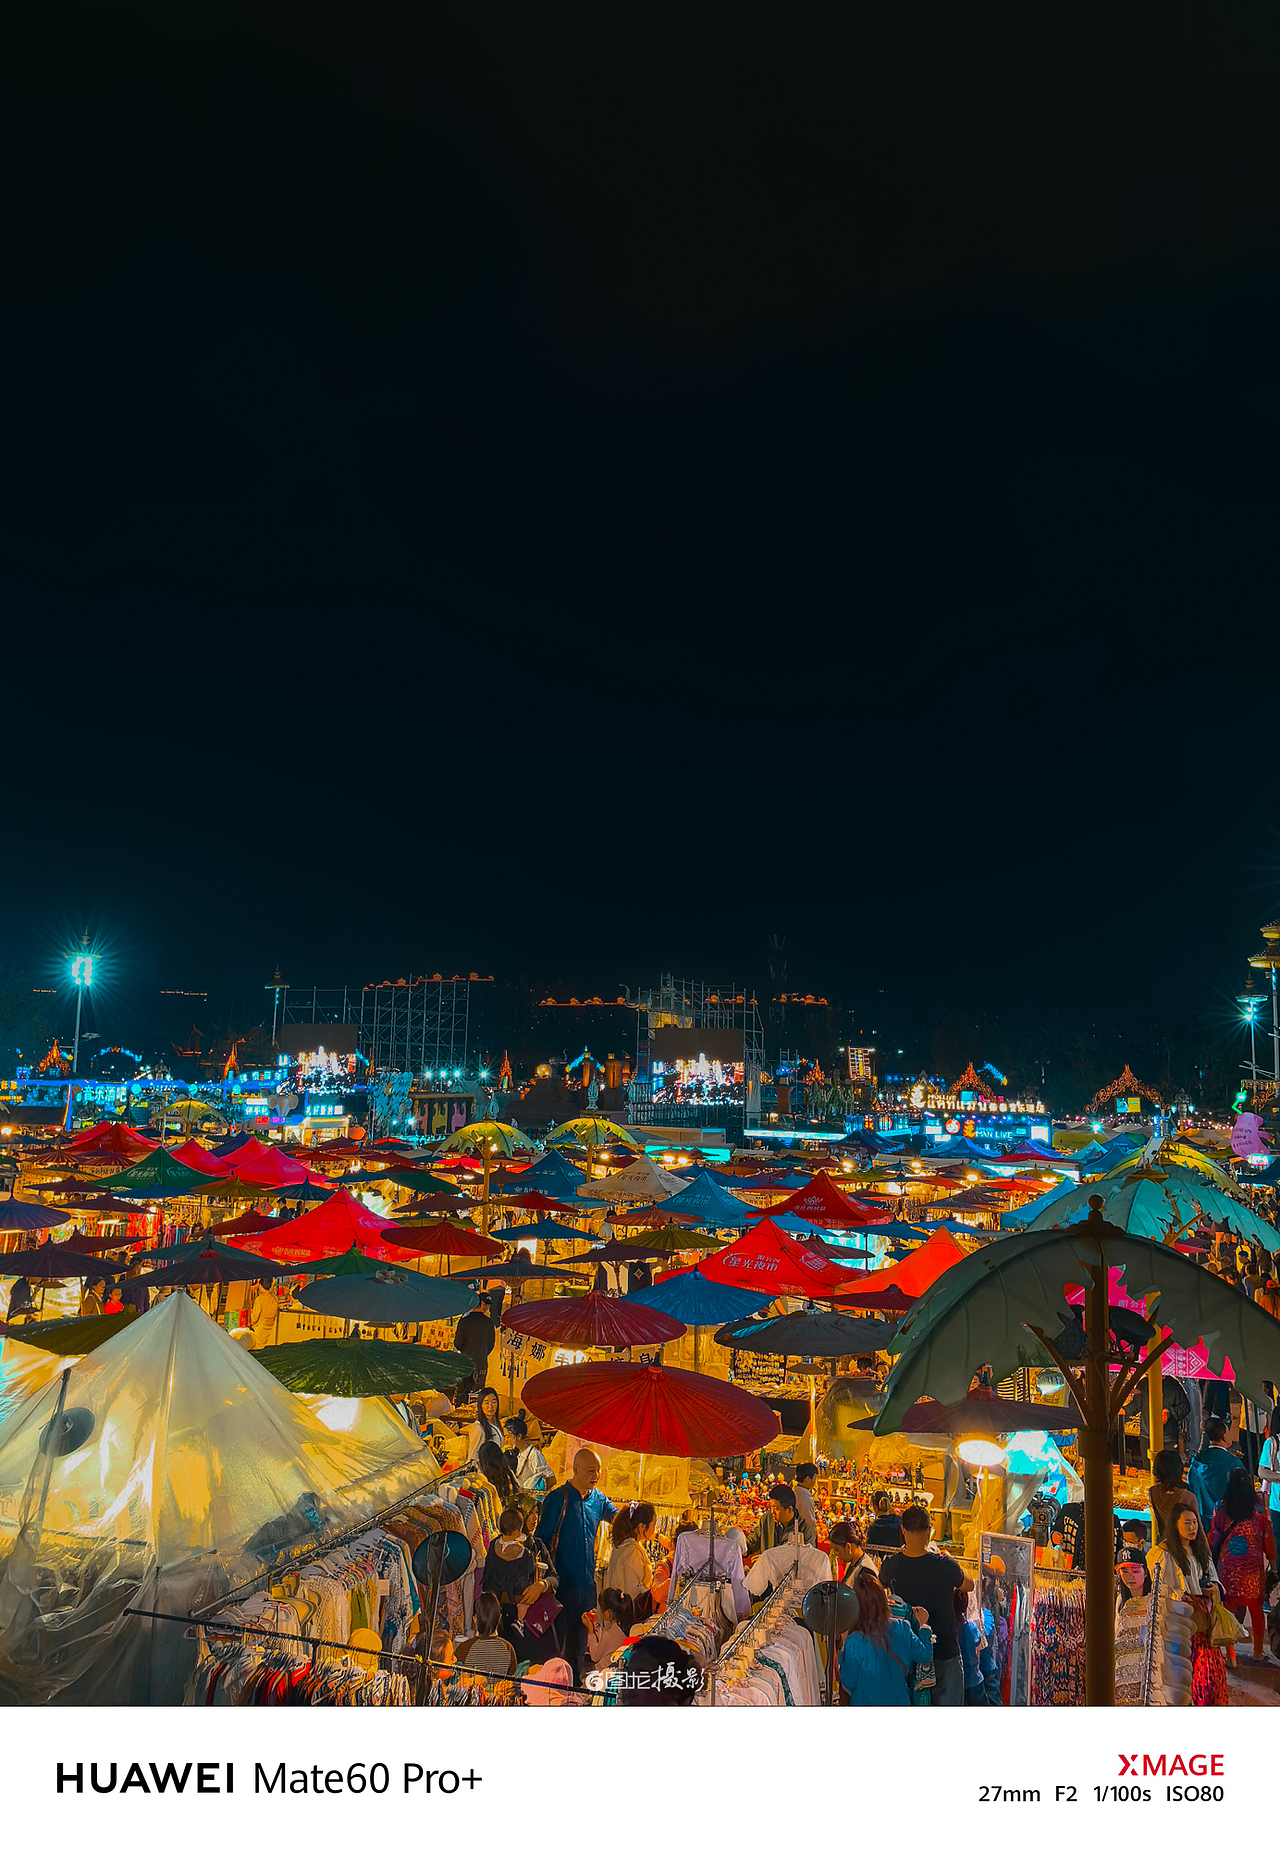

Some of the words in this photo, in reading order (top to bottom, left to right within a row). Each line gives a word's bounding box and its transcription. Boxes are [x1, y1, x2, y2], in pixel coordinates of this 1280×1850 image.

[83, 1085, 127, 1103] 音乐酒吧
[995, 1131, 1013, 1140] LIVE
[728, 1256, 779, 1272] 星光夜市
